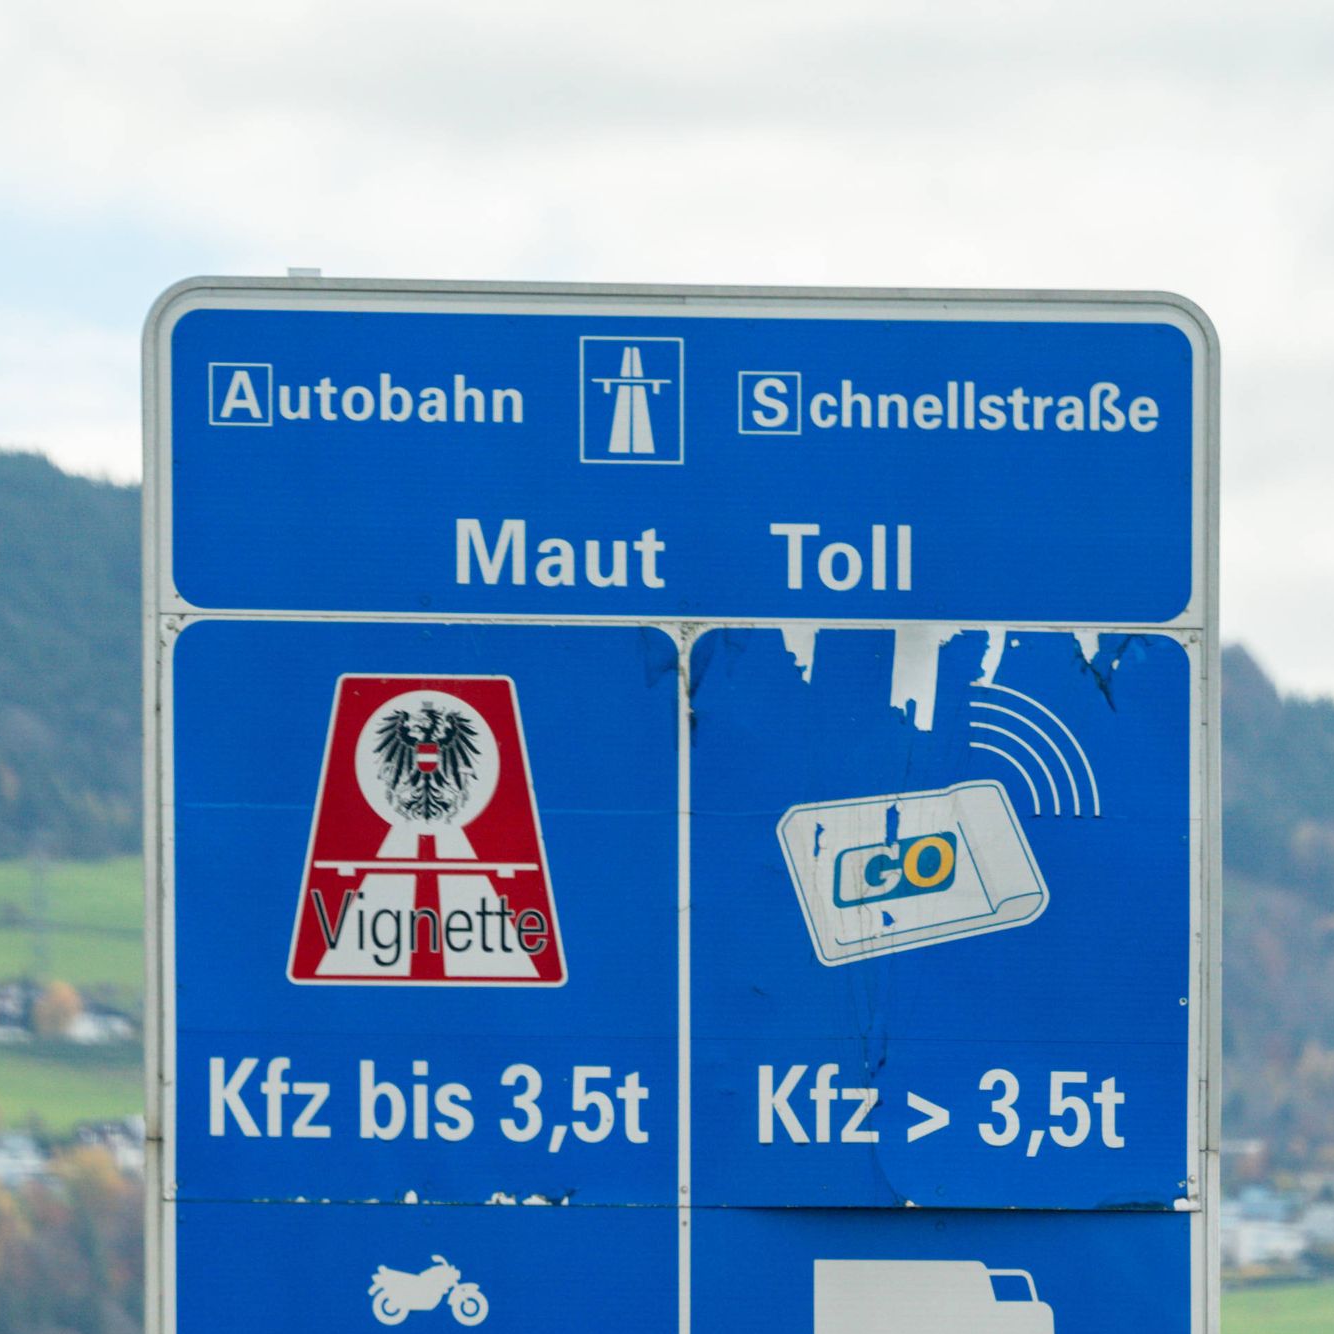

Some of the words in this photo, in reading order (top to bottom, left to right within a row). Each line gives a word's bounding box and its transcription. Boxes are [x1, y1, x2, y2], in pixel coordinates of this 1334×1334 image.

[220, 370, 524, 424] Autobahn
[752, 378, 1160, 433] Schnellstraße
[456, 518, 666, 590] Maut
[770, 523, 913, 592] Toll
[839, 835, 956, 903] GO
[311, 889, 548, 968] Vignette
[209, 1057, 331, 1139] Kfz
[360, 1060, 474, 1141] bis
[500, 1063, 650, 1153] 3,5t
[758, 1063, 880, 1145] Kfz
[978, 1068, 1126, 1157] 3,5t
